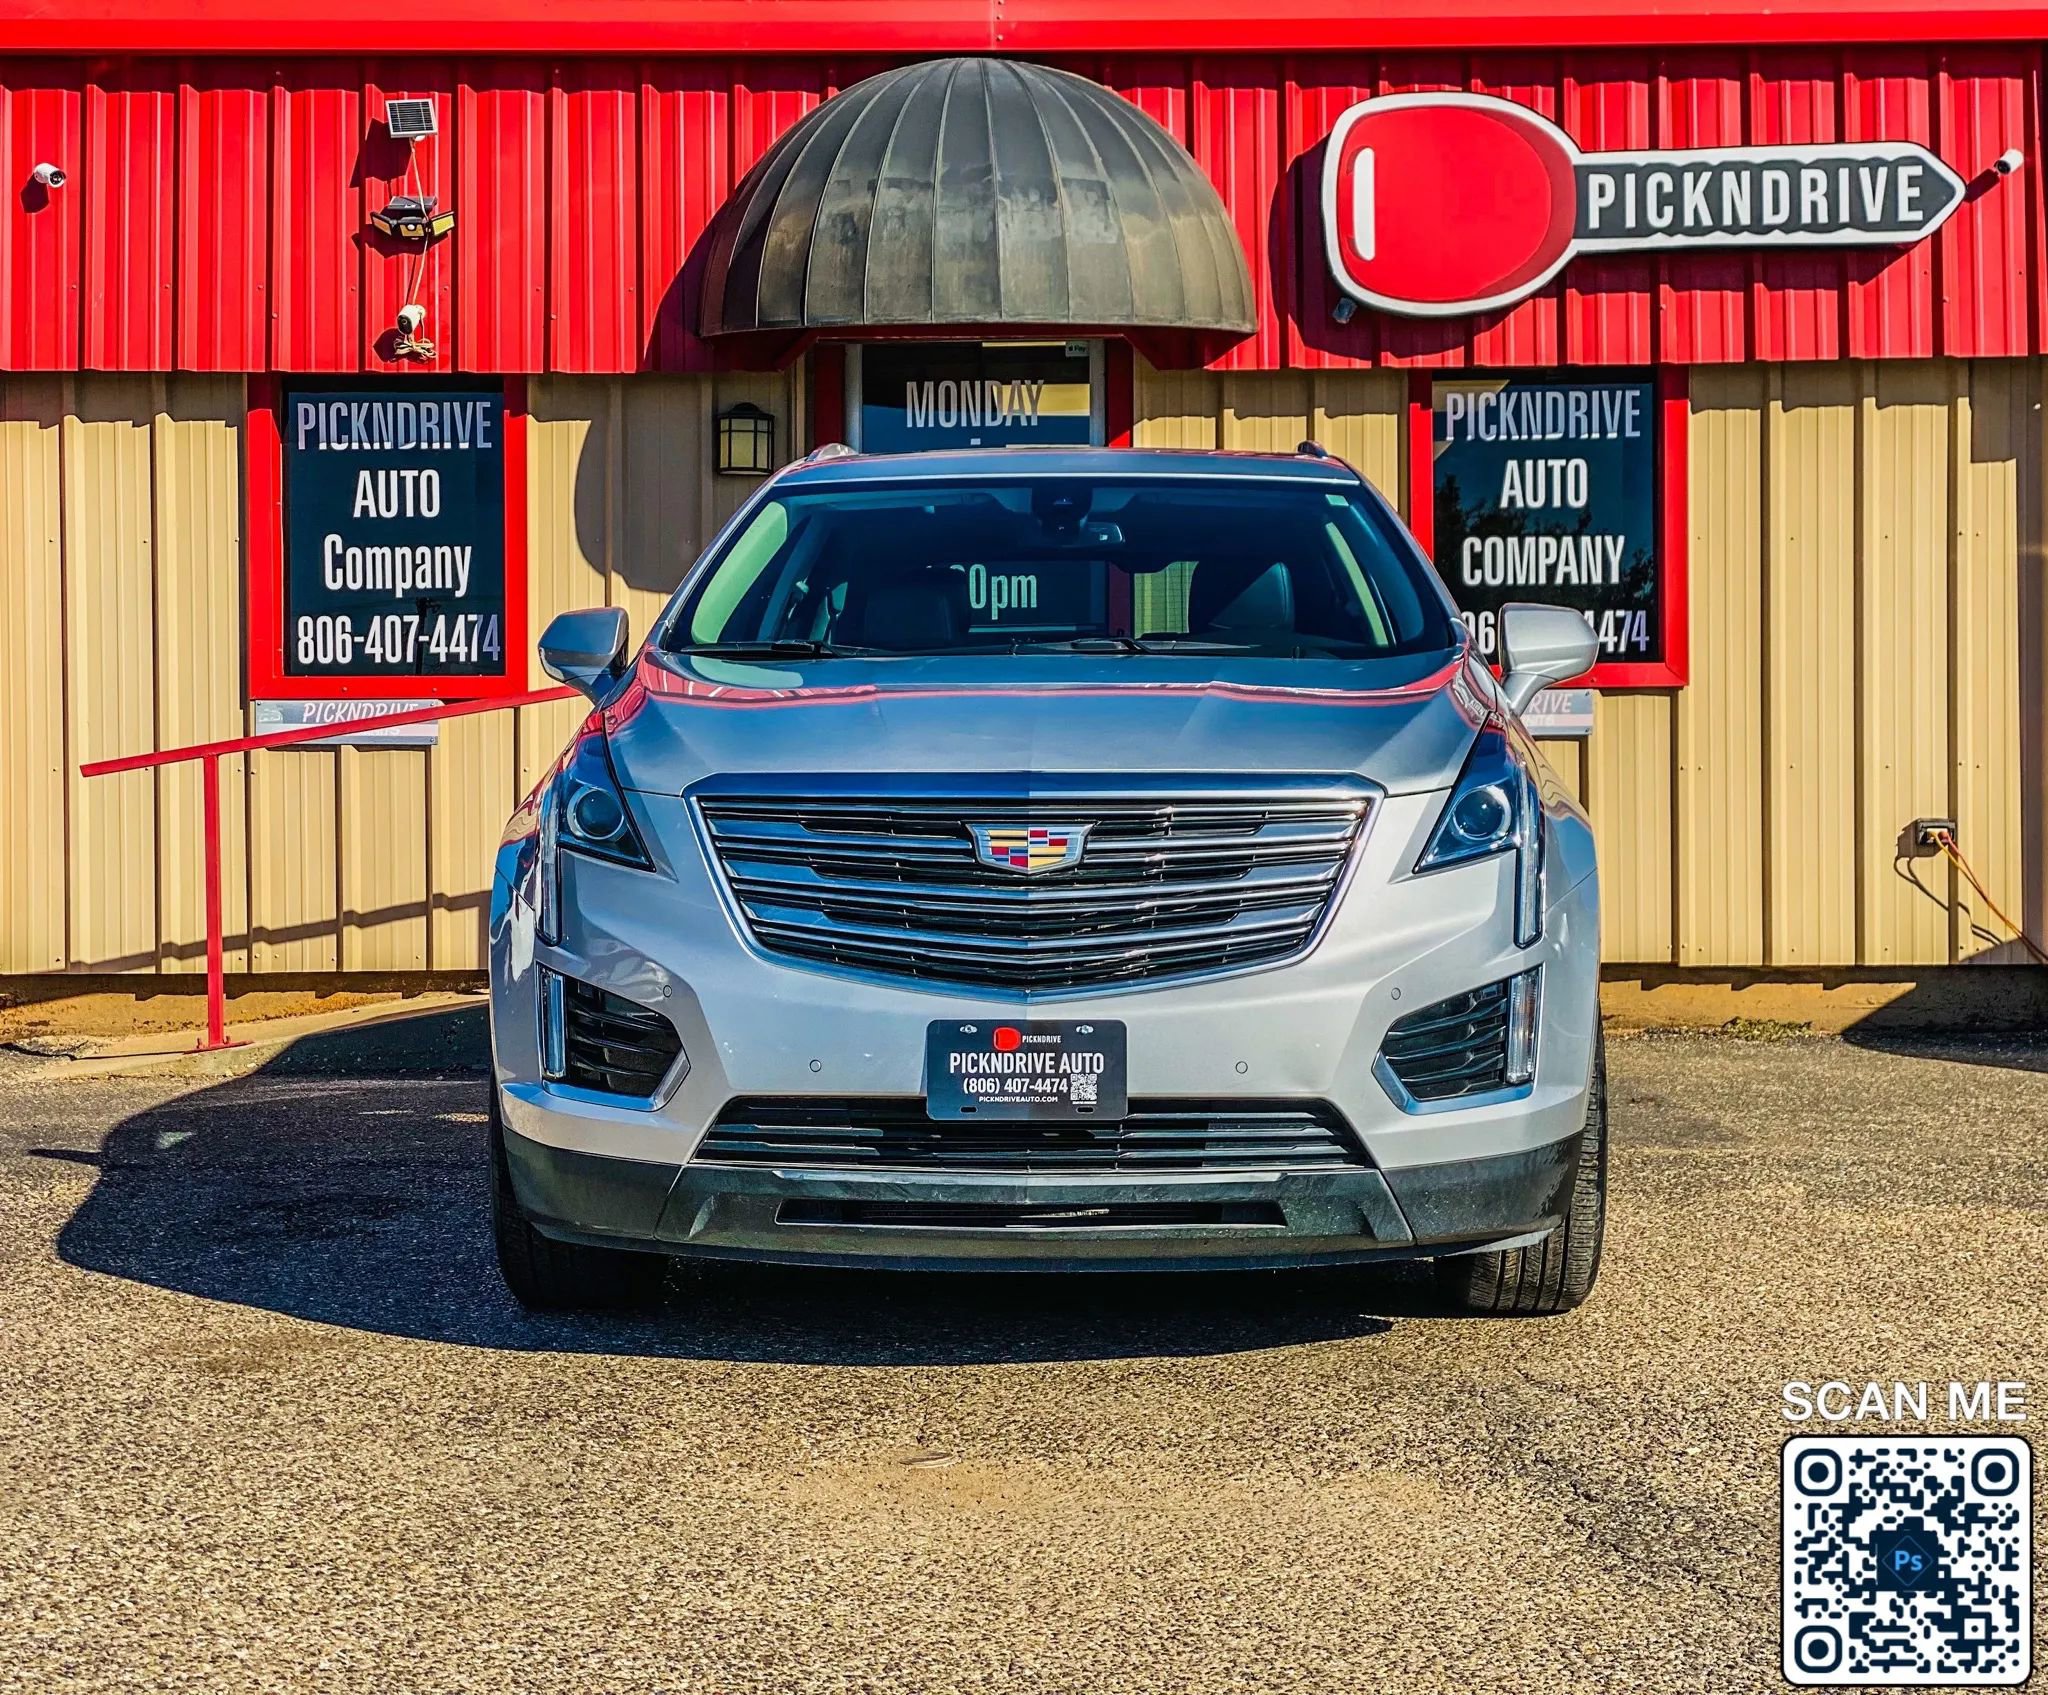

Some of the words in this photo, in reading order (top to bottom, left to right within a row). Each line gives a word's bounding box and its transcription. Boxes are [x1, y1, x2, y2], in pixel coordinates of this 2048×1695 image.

[1588, 164, 1926, 230] PICKNDRIVE
[297, 401, 492, 450] PICKNDRIVE
[906, 379, 1045, 428] MONDAY
[1446, 389, 1641, 441] PICKNDRIVE
[353, 469, 440, 518] AUTO
[1499, 457, 1589, 509] AUTO
[323, 533, 472, 598] Company
[1462, 535, 1625, 586] COMPANY
[950, 564, 1038, 620] 0pm
[297, 613, 501, 665] 806-407-4474
[303, 702, 419, 723] PICKNDRI
[949, 1052, 1055, 1074] PICKNDRIVE
[1059, 1052, 1105, 1074] AUTO
[1022, 1034, 1062, 1044] PICKNDRIVE
[963, 1077, 1000, 1094] (806)
[1003, 1077, 1069, 1093] 407-4474
[978, 1095, 1058, 1103] PICKNDRIVEAUTO.COM
